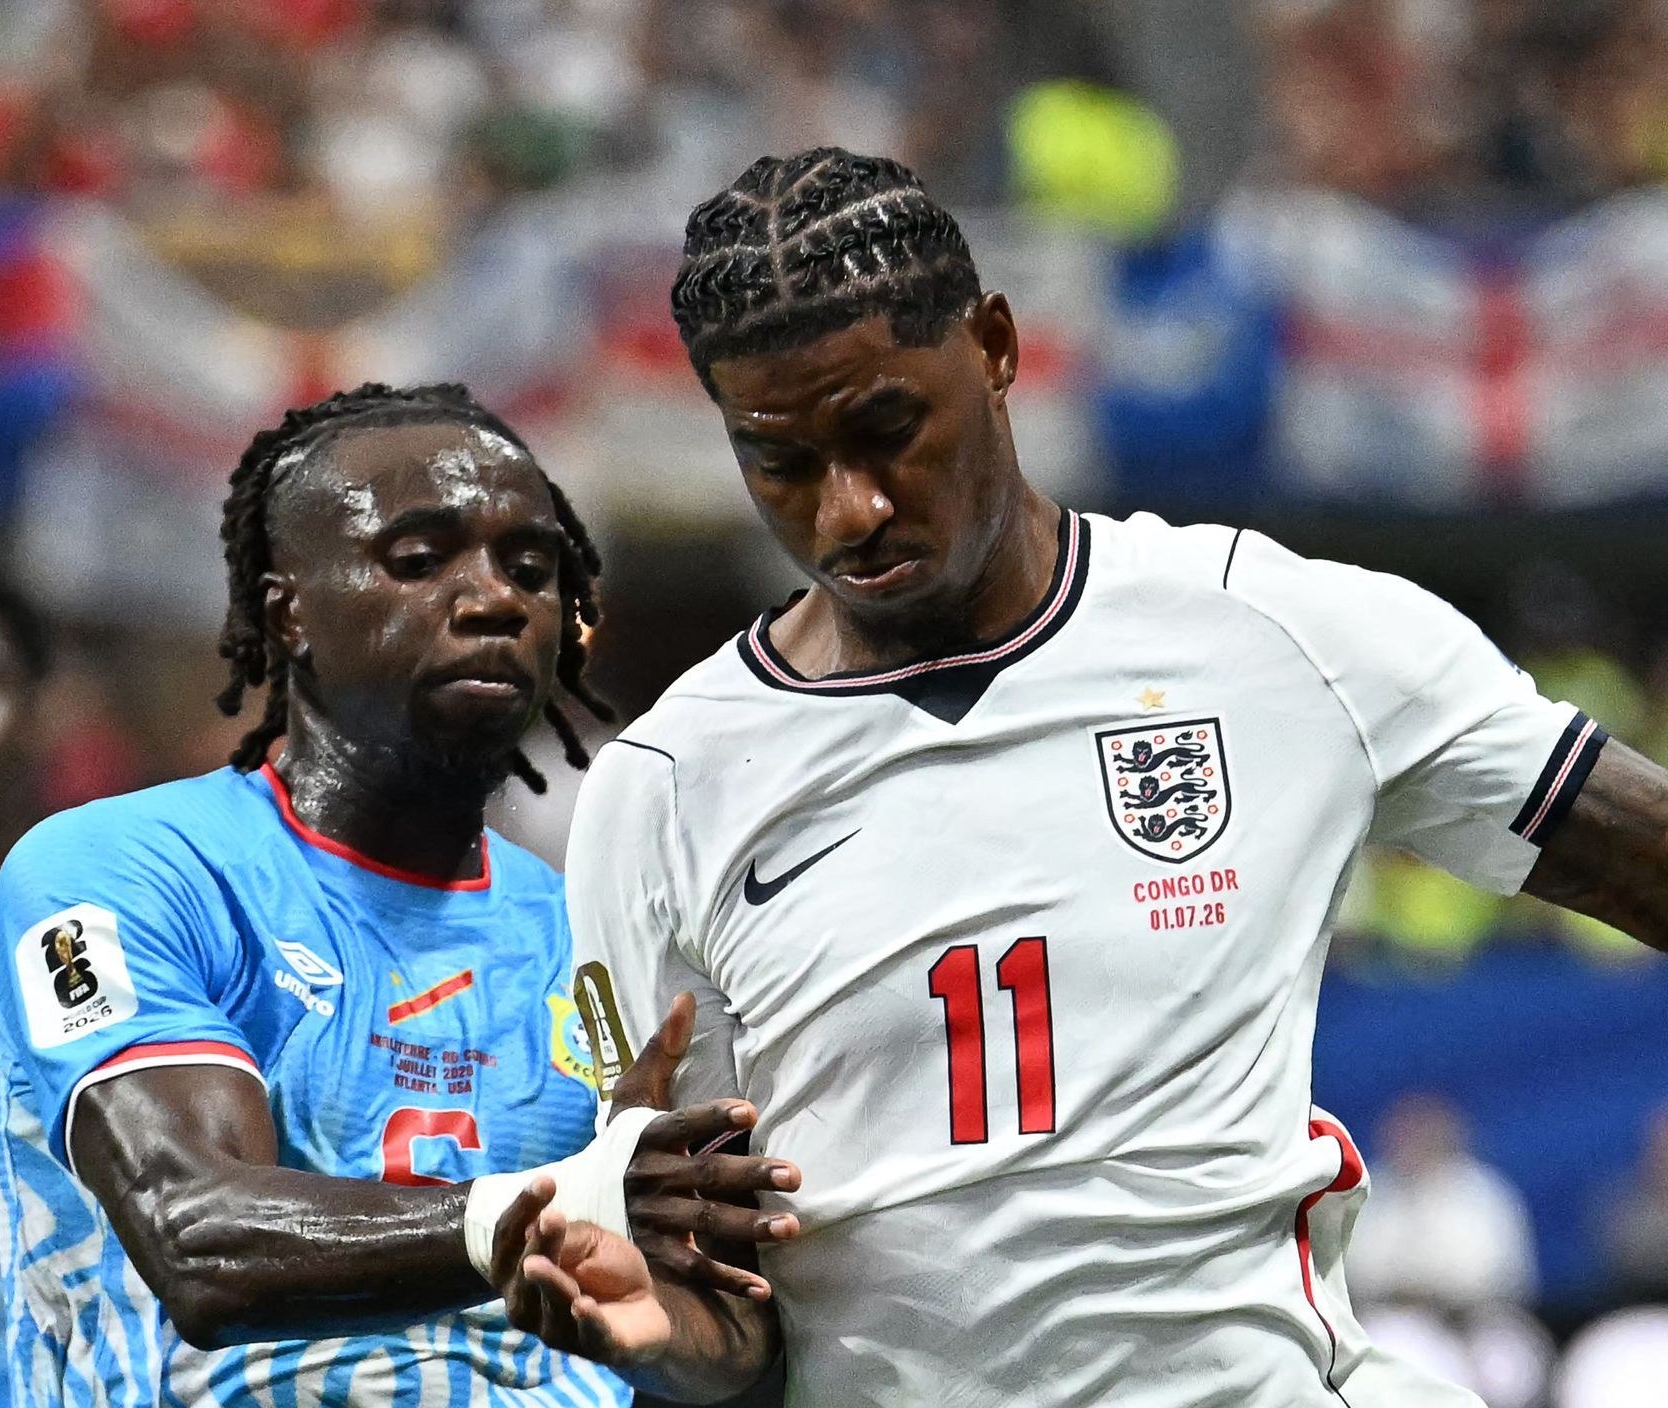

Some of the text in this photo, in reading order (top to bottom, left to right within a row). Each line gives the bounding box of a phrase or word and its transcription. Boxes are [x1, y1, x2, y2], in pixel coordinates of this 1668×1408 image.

[1133, 868, 1239, 903] CONGO DR
[1150, 902, 1225, 930] 01.07.26
[928, 936, 1056, 1145] 11
[447, 1080, 472, 1094] USA
